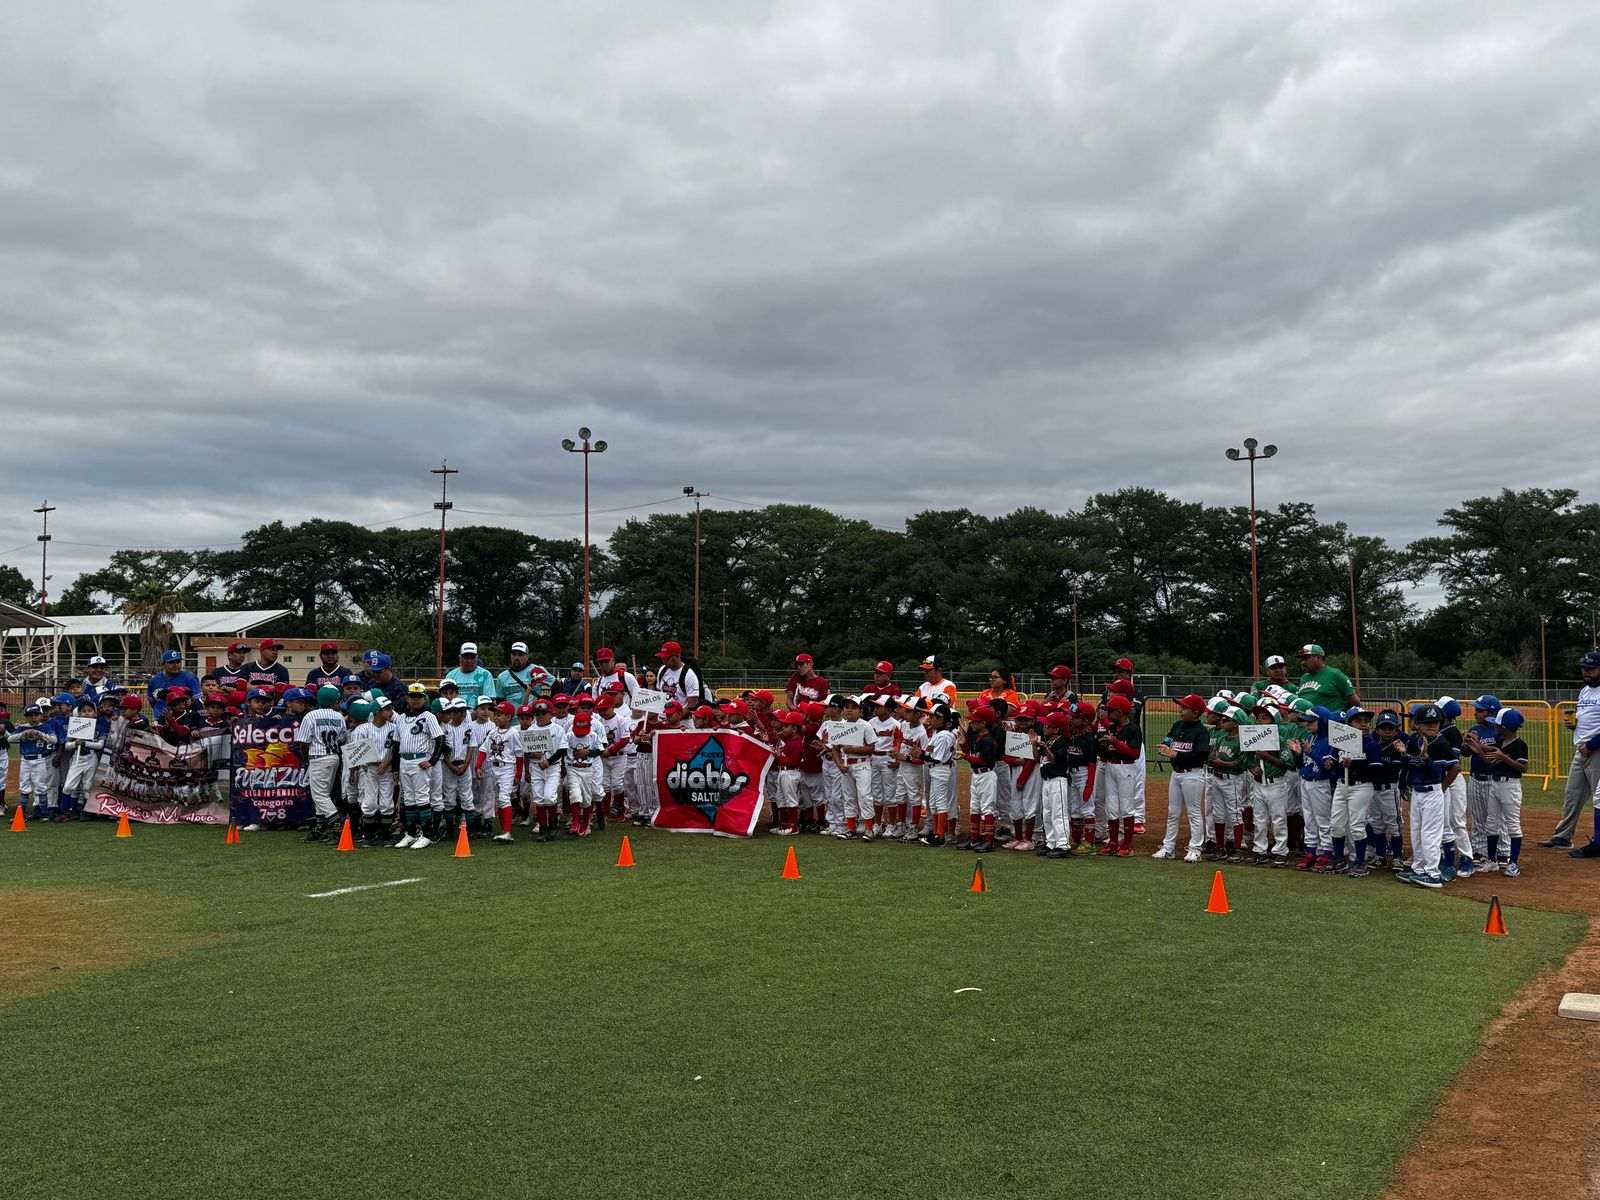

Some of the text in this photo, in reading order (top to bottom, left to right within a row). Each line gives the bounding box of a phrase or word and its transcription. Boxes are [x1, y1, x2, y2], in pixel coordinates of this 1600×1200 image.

[634, 695, 661, 707] DIABLOS
[233, 721, 302, 744] Selecci
[830, 725, 859, 742] GIGANTES
[1243, 727, 1273, 748] SABINAS
[1332, 732, 1357, 744] DODGERS
[527, 743, 548, 751] NORTE
[1008, 739, 1033, 753] VAQUERO
[666, 762, 748, 793] diabos
